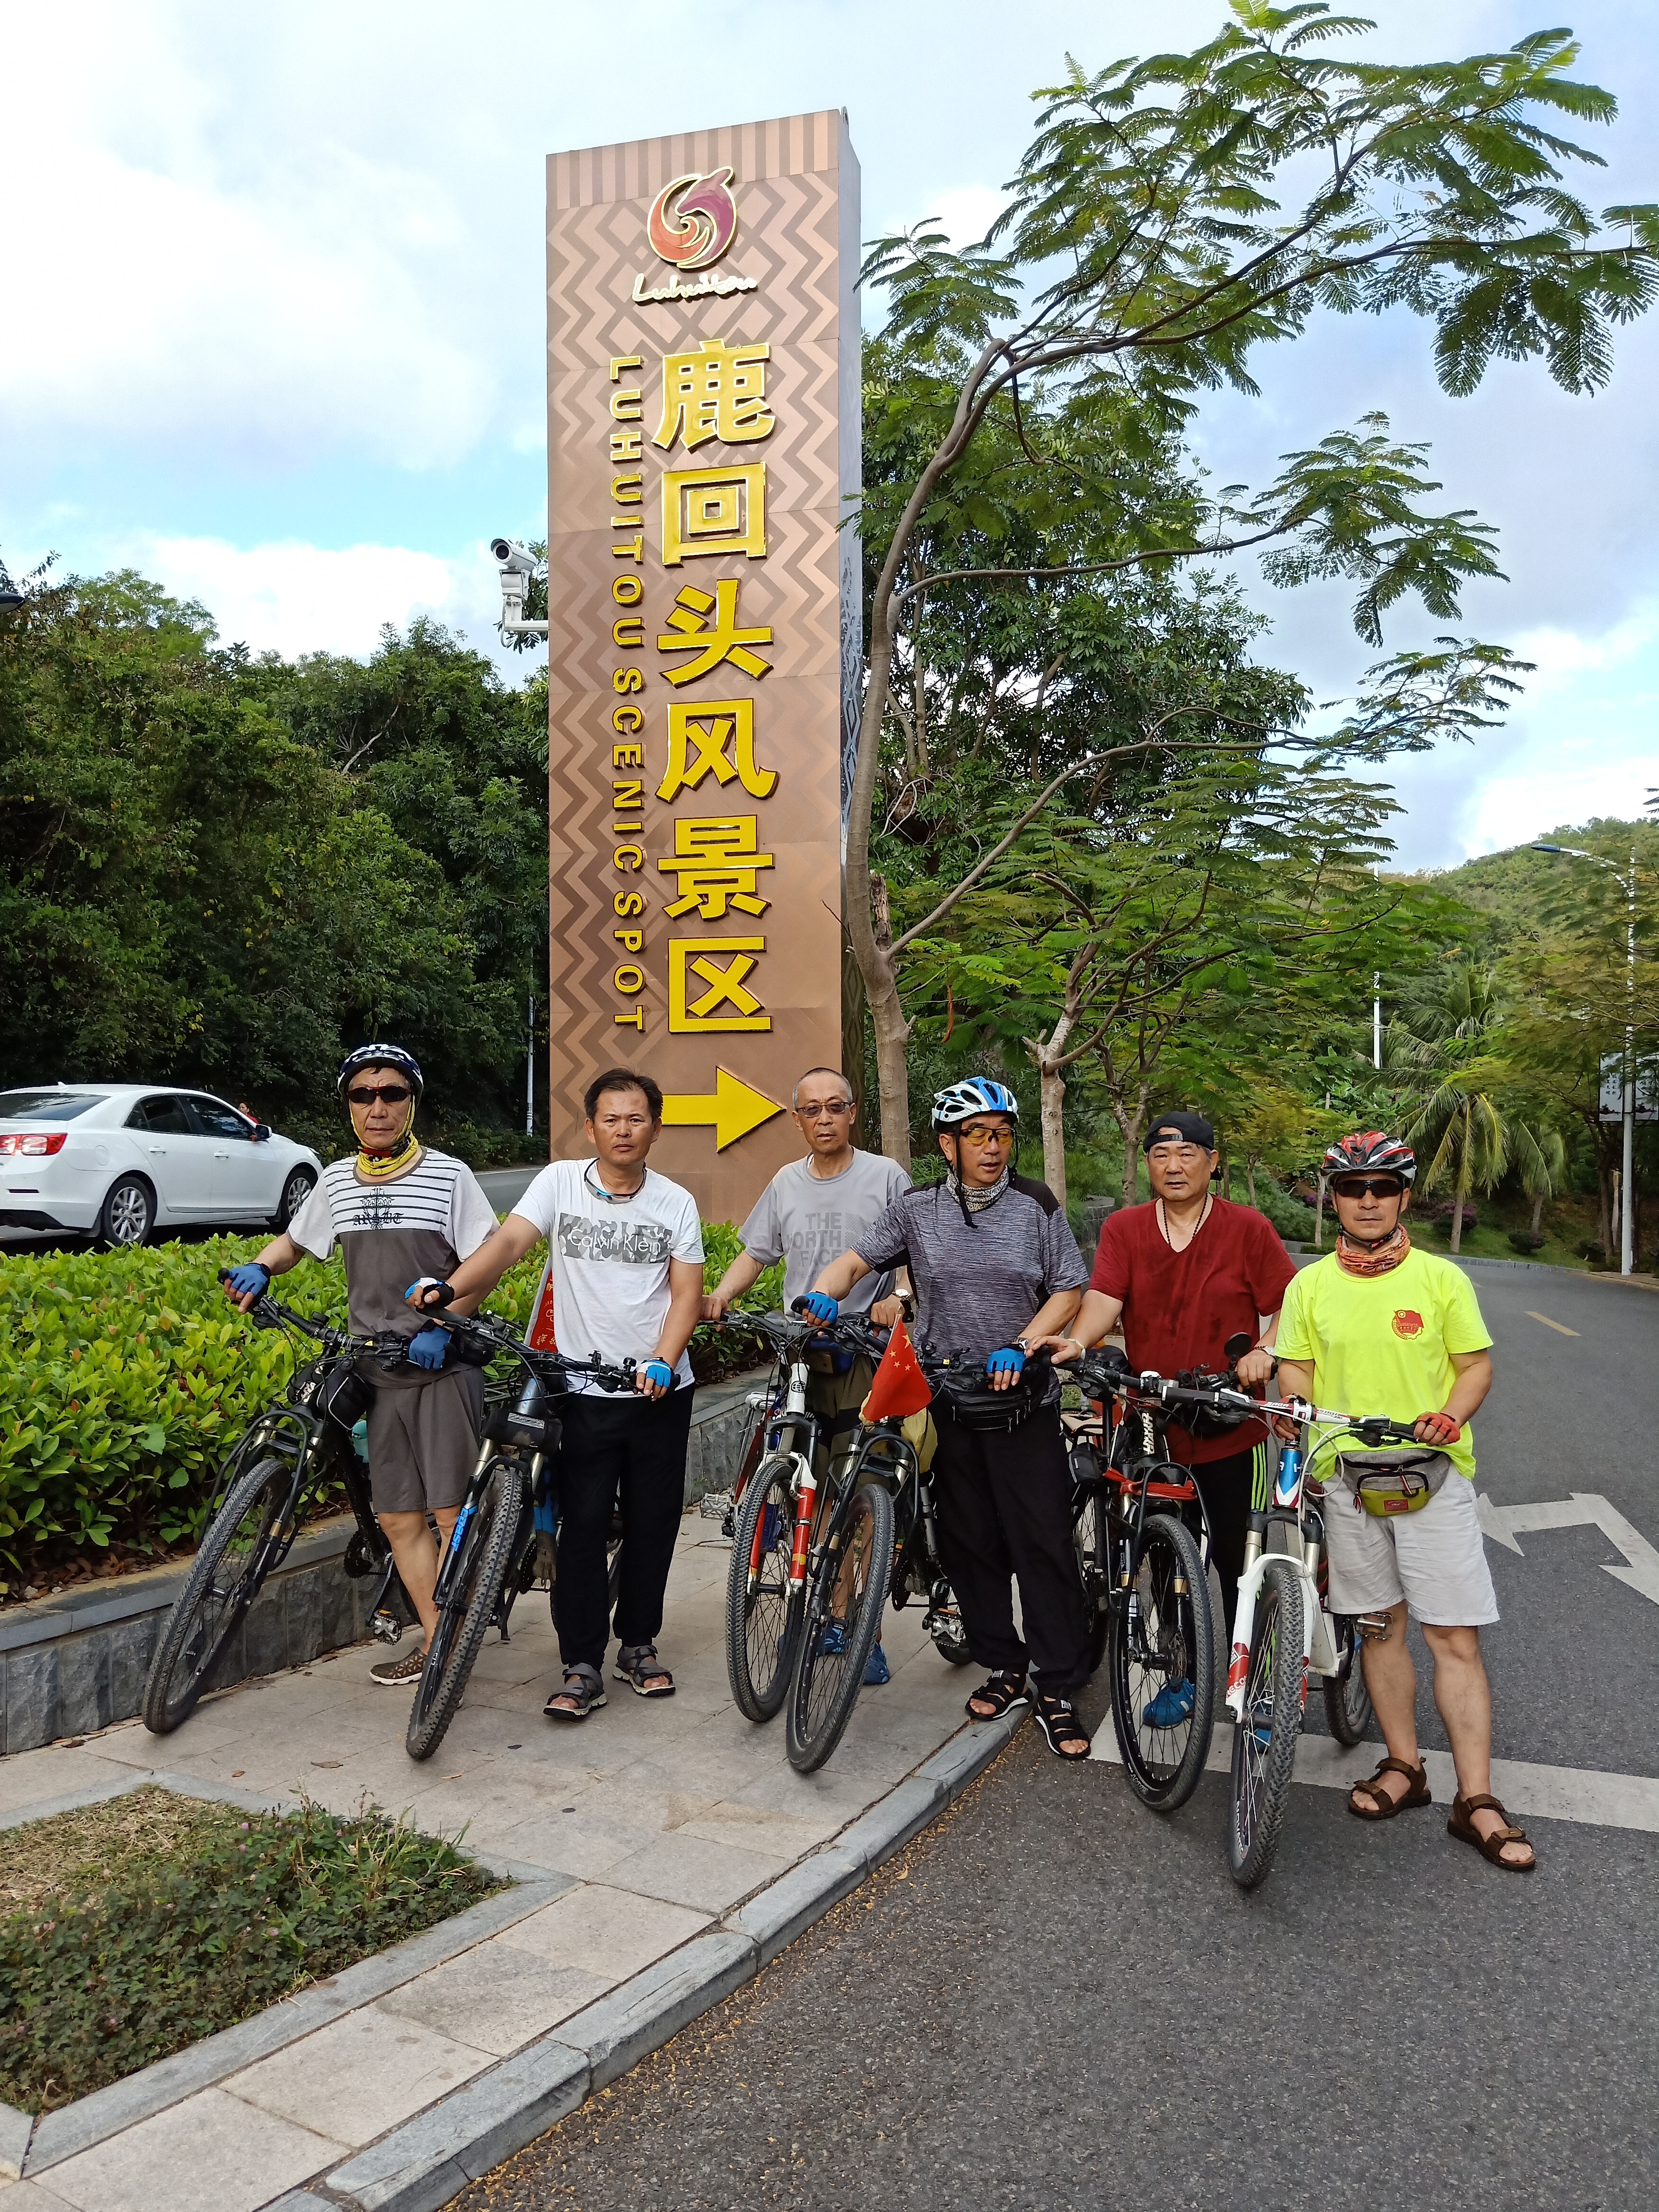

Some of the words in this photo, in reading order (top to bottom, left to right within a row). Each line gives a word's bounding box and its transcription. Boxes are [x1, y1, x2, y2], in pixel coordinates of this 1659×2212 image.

[610, 355, 644, 648] LUHUITOU
[612, 667, 645, 872] SCENIC
[651, 338, 779, 1033] 鹿回头风景区
[613, 890, 646, 1032] SPOT
[570, 1228, 620, 1250] Calvin
[624, 1234, 661, 1253] Klein
[805, 1212, 842, 1230] THE
